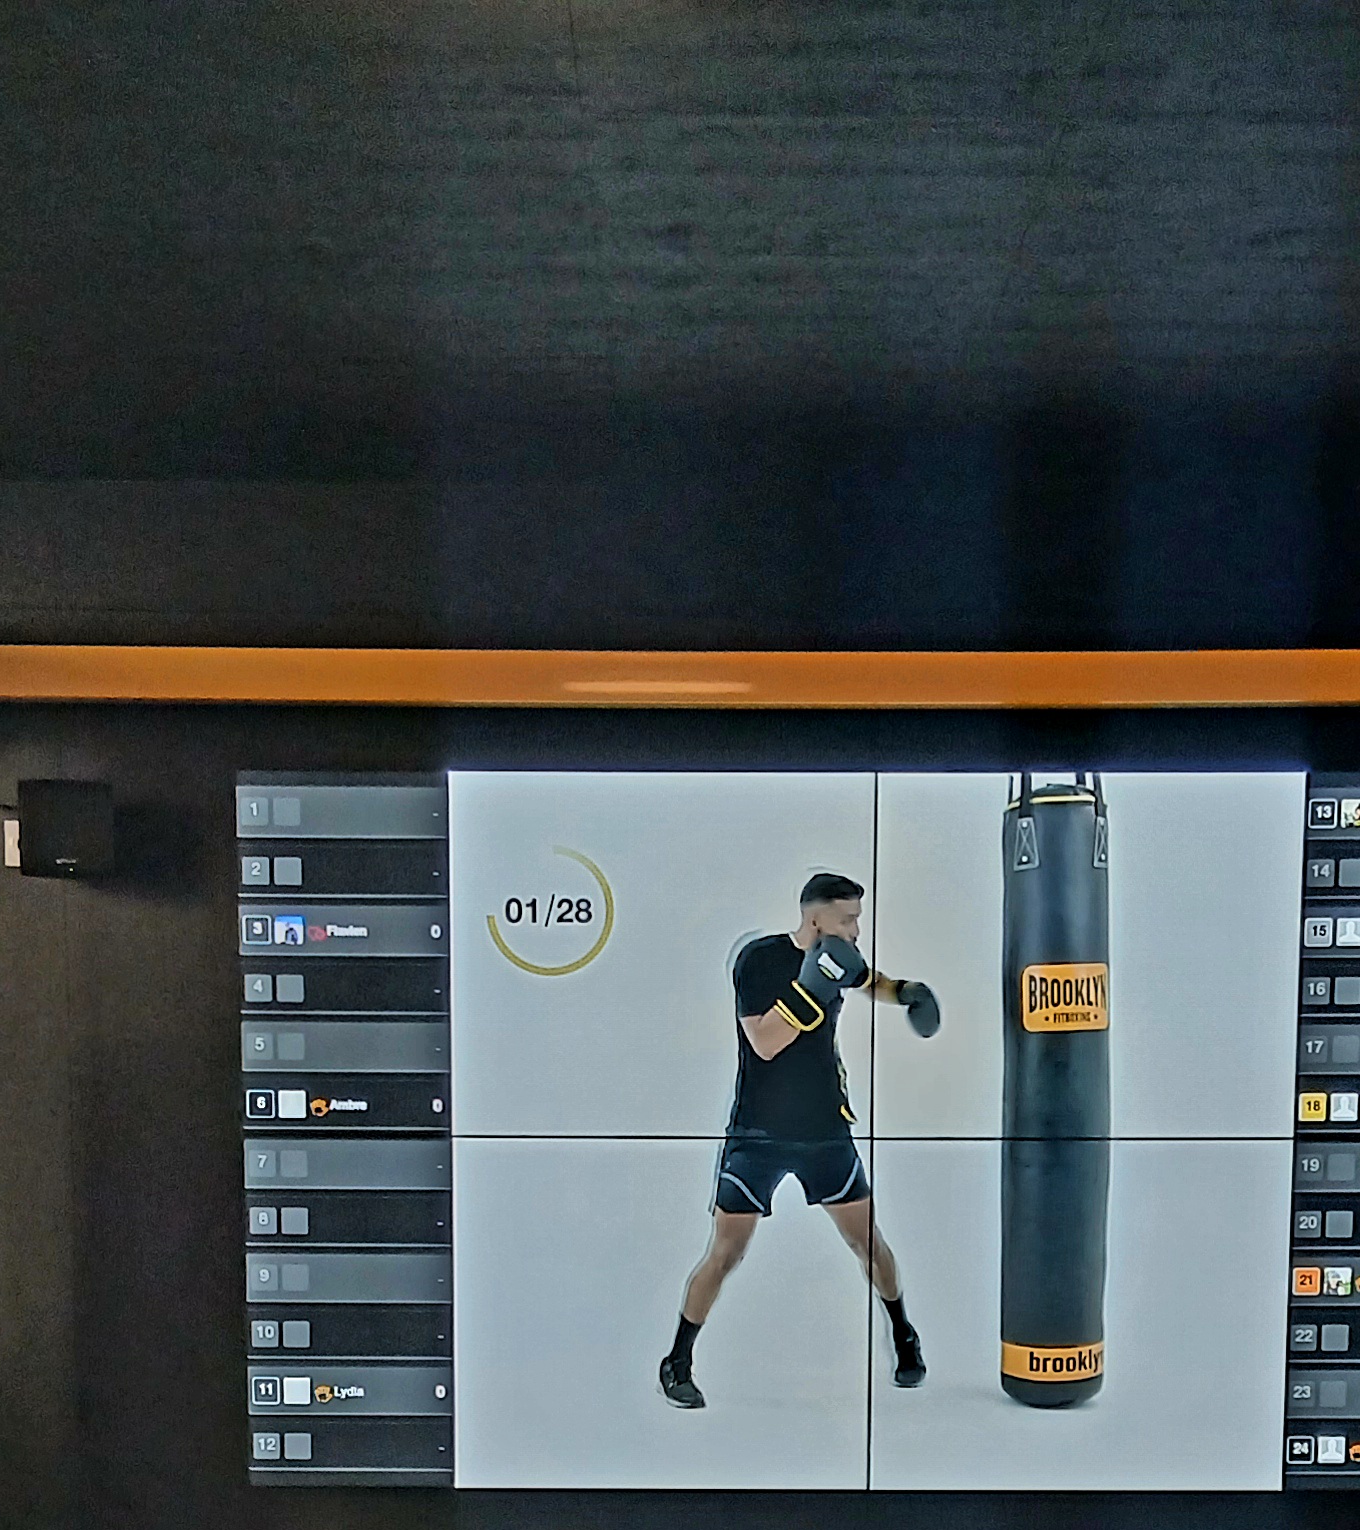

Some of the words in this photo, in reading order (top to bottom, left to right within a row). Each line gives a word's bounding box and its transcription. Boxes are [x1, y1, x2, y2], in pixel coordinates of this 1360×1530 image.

[250, 803, 259, 816] 1
[1316, 806, 1331, 819] 13
[251, 863, 261, 876] 2
[1311, 865, 1330, 877] 14
[505, 894, 593, 927] 01/28
[1312, 925, 1327, 937] 15
[253, 980, 263, 993] 4
[1029, 973, 1107, 1013] BROOKLYN
[1307, 983, 1326, 996] 16
[255, 1037, 264, 1050] 5
[1305, 1041, 1324, 1053] 17
[1306, 1101, 1321, 1112] 18
[257, 1155, 267, 1168] 7
[1301, 1159, 1320, 1172] 19
[1299, 1216, 1318, 1230] 20
[259, 1269, 269, 1282] 9
[1300, 1275, 1313, 1287] 21
[257, 1326, 274, 1339] 10
[1295, 1330, 1314, 1343] 22
[259, 1383, 273, 1396] 11
[334, 1386, 364, 1398] Lydia
[1293, 1386, 1311, 1399] 23
[258, 1438, 276, 1451] 12
[1293, 1443, 1309, 1455] 24
